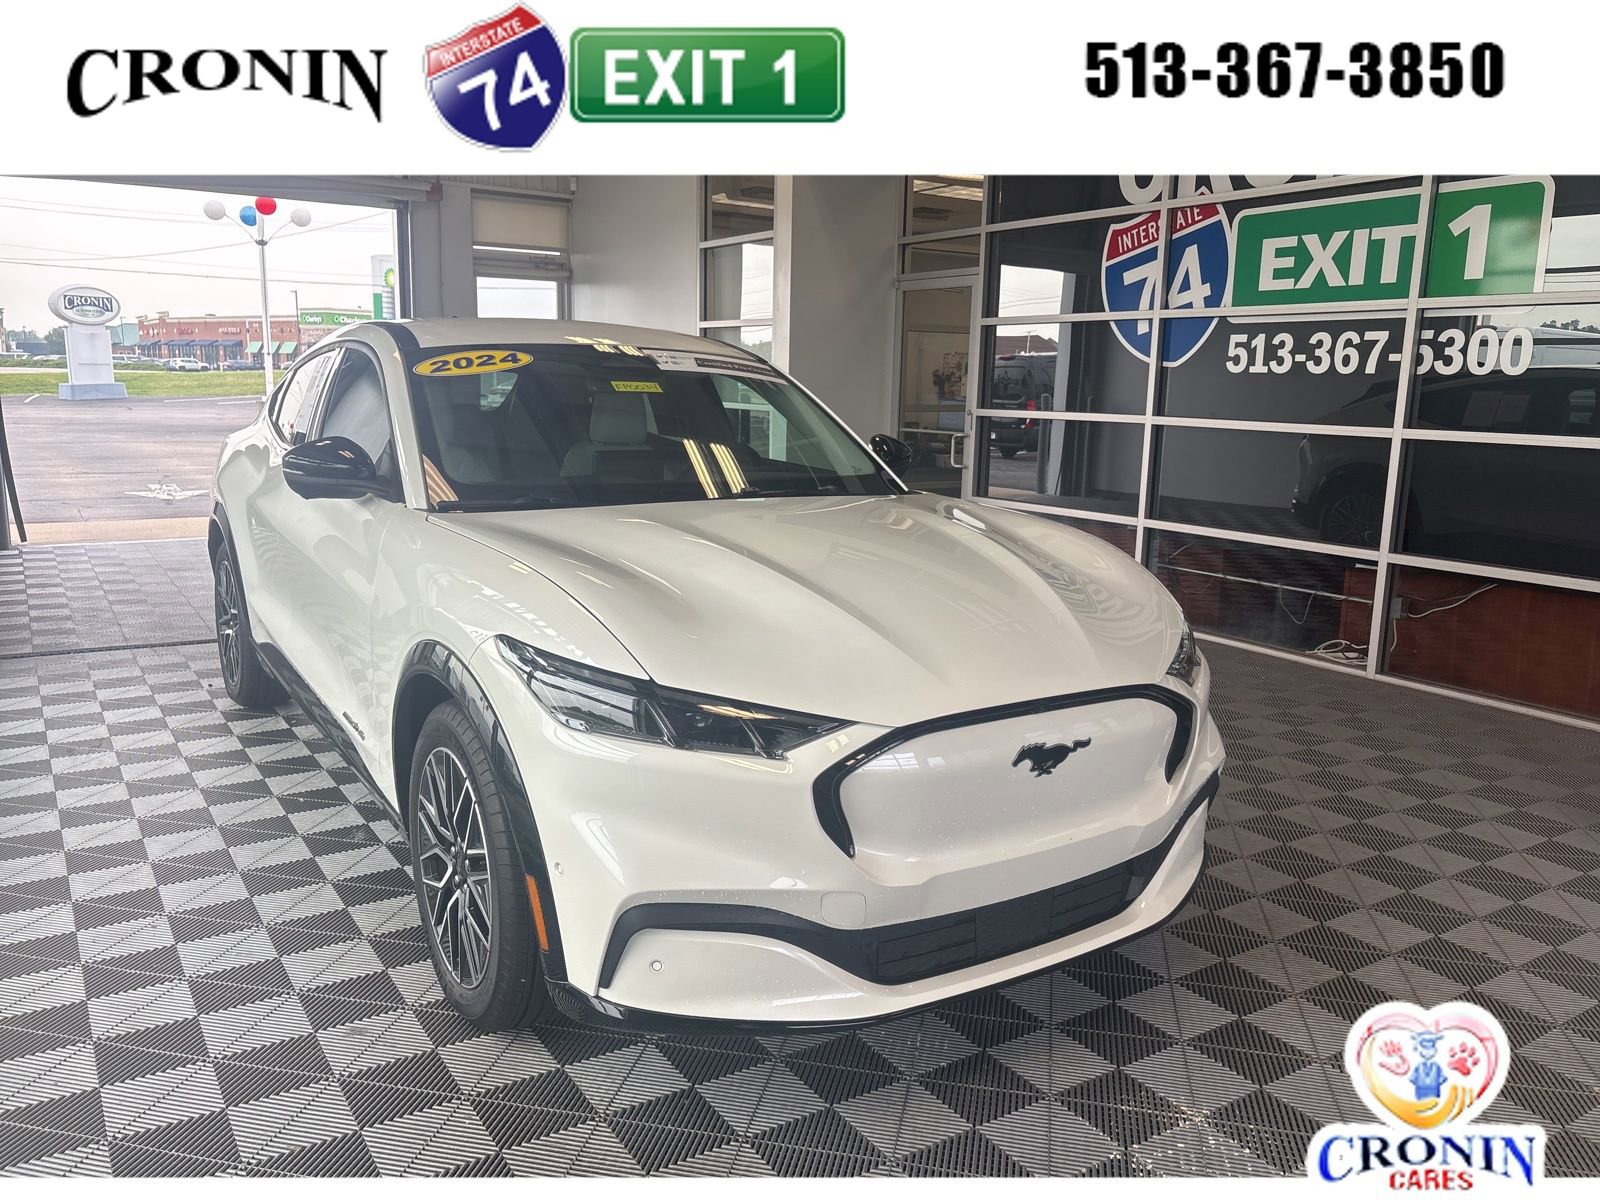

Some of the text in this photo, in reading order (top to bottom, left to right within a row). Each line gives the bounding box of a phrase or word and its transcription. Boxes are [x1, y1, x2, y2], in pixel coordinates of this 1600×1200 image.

[1118, 207, 1203, 253] INTERATE
[1258, 204, 1492, 291] EXIT 1
[65, 296, 113, 311] CRONIN
[1123, 243, 1212, 335] 74
[429, 353, 522, 373] 2024
[1225, 328, 1534, 376] 513-367-5300
